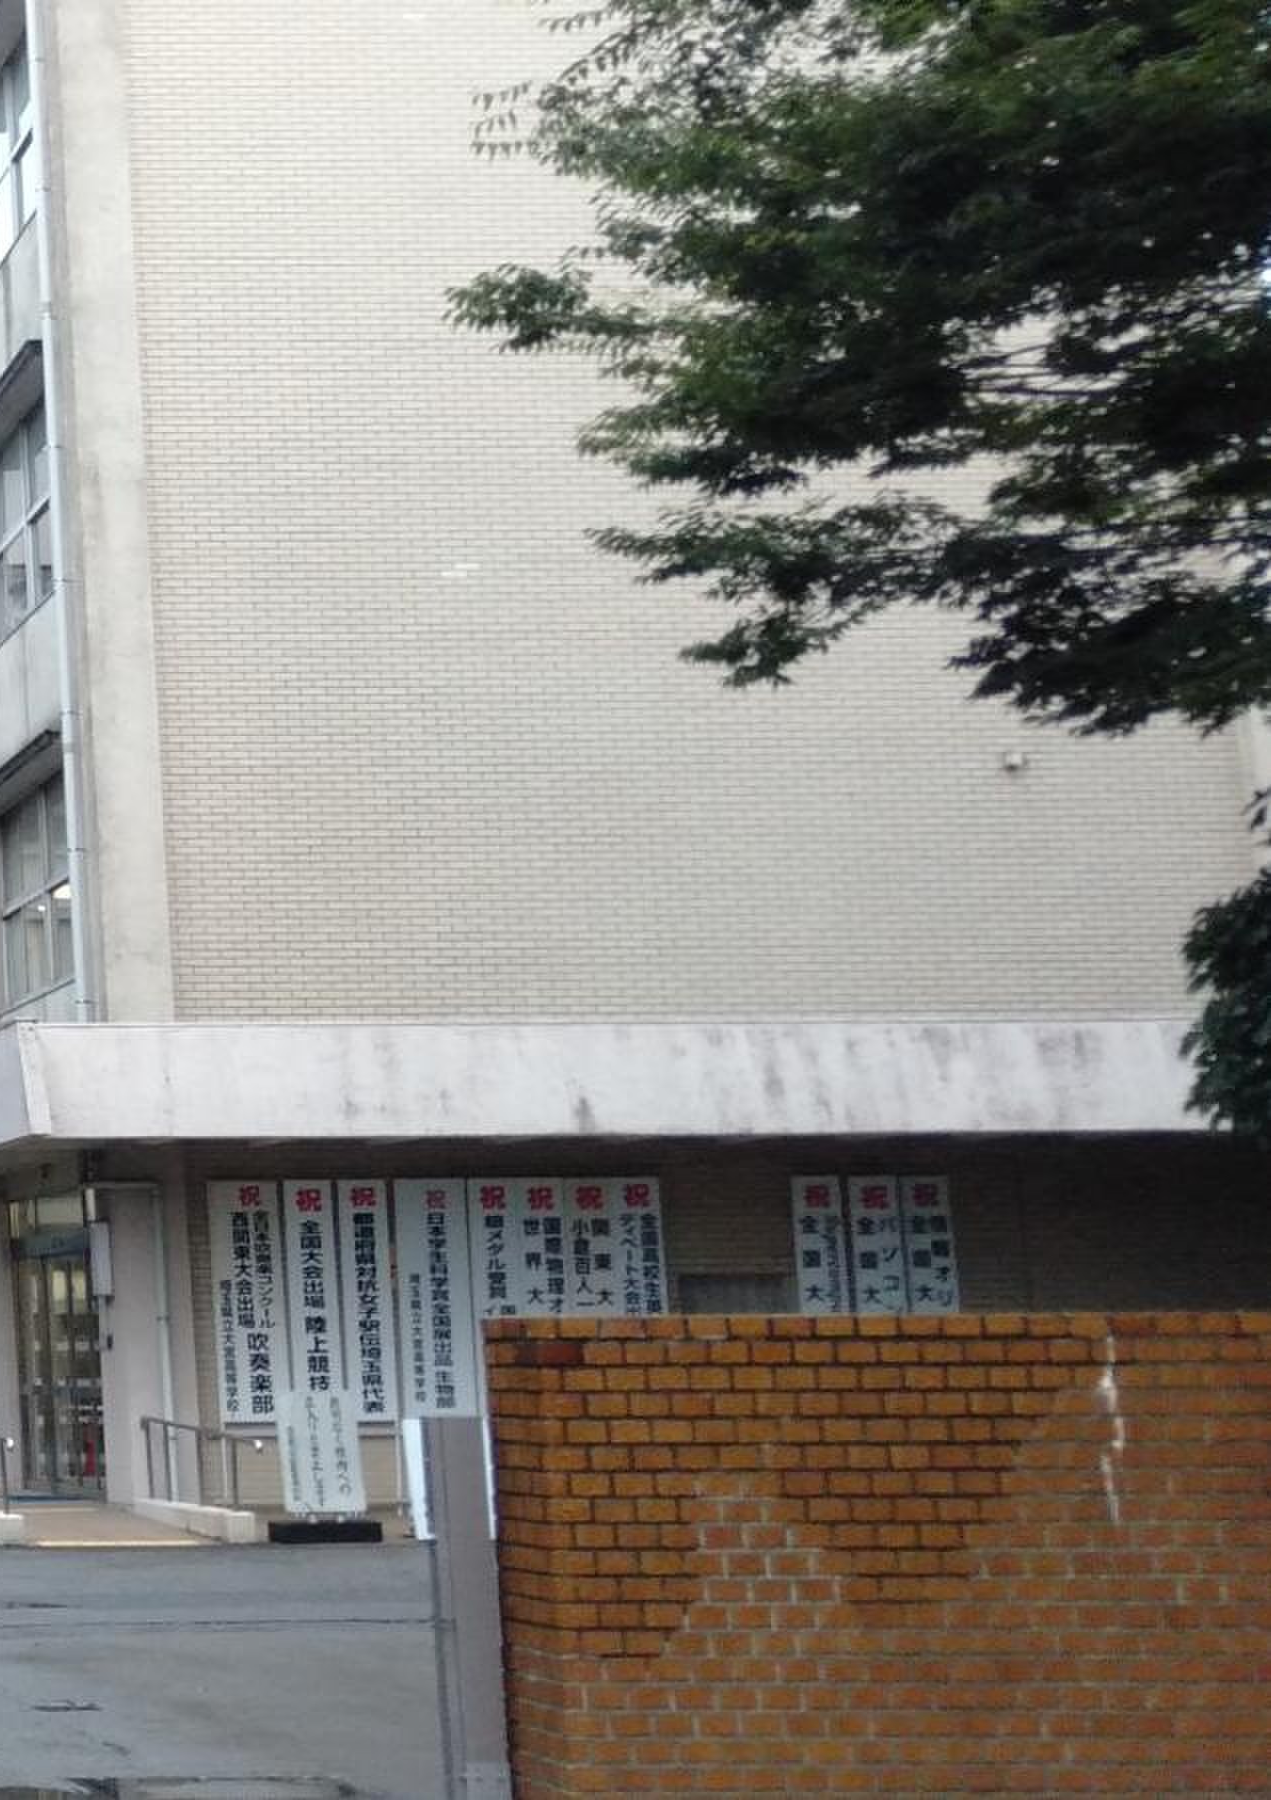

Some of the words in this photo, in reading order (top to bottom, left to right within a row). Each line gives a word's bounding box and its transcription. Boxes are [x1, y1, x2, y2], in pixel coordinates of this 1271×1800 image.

[240, 1185, 262, 1206] 祝
[296, 1188, 323, 1212] 祝
[350, 1186, 377, 1208] 祝
[424, 1189, 447, 1209] 祝
[479, 1184, 507, 1210] 祝
[526, 1187, 554, 1210] 祝
[574, 1186, 604, 1211] 祝
[623, 1184, 651, 1208] 祝
[803, 1184, 830, 1208] 祝
[230, 1211, 255, 1328] 西関東大会出場
[299, 1219, 326, 1309] 全国大会出場
[352, 1212, 386, 1413] 都道府県対抗女子駅伝埼玉県代表
[305, 1316, 331, 1391] 陸上競技
[247, 1333, 275, 1414] 吹奏楽部
